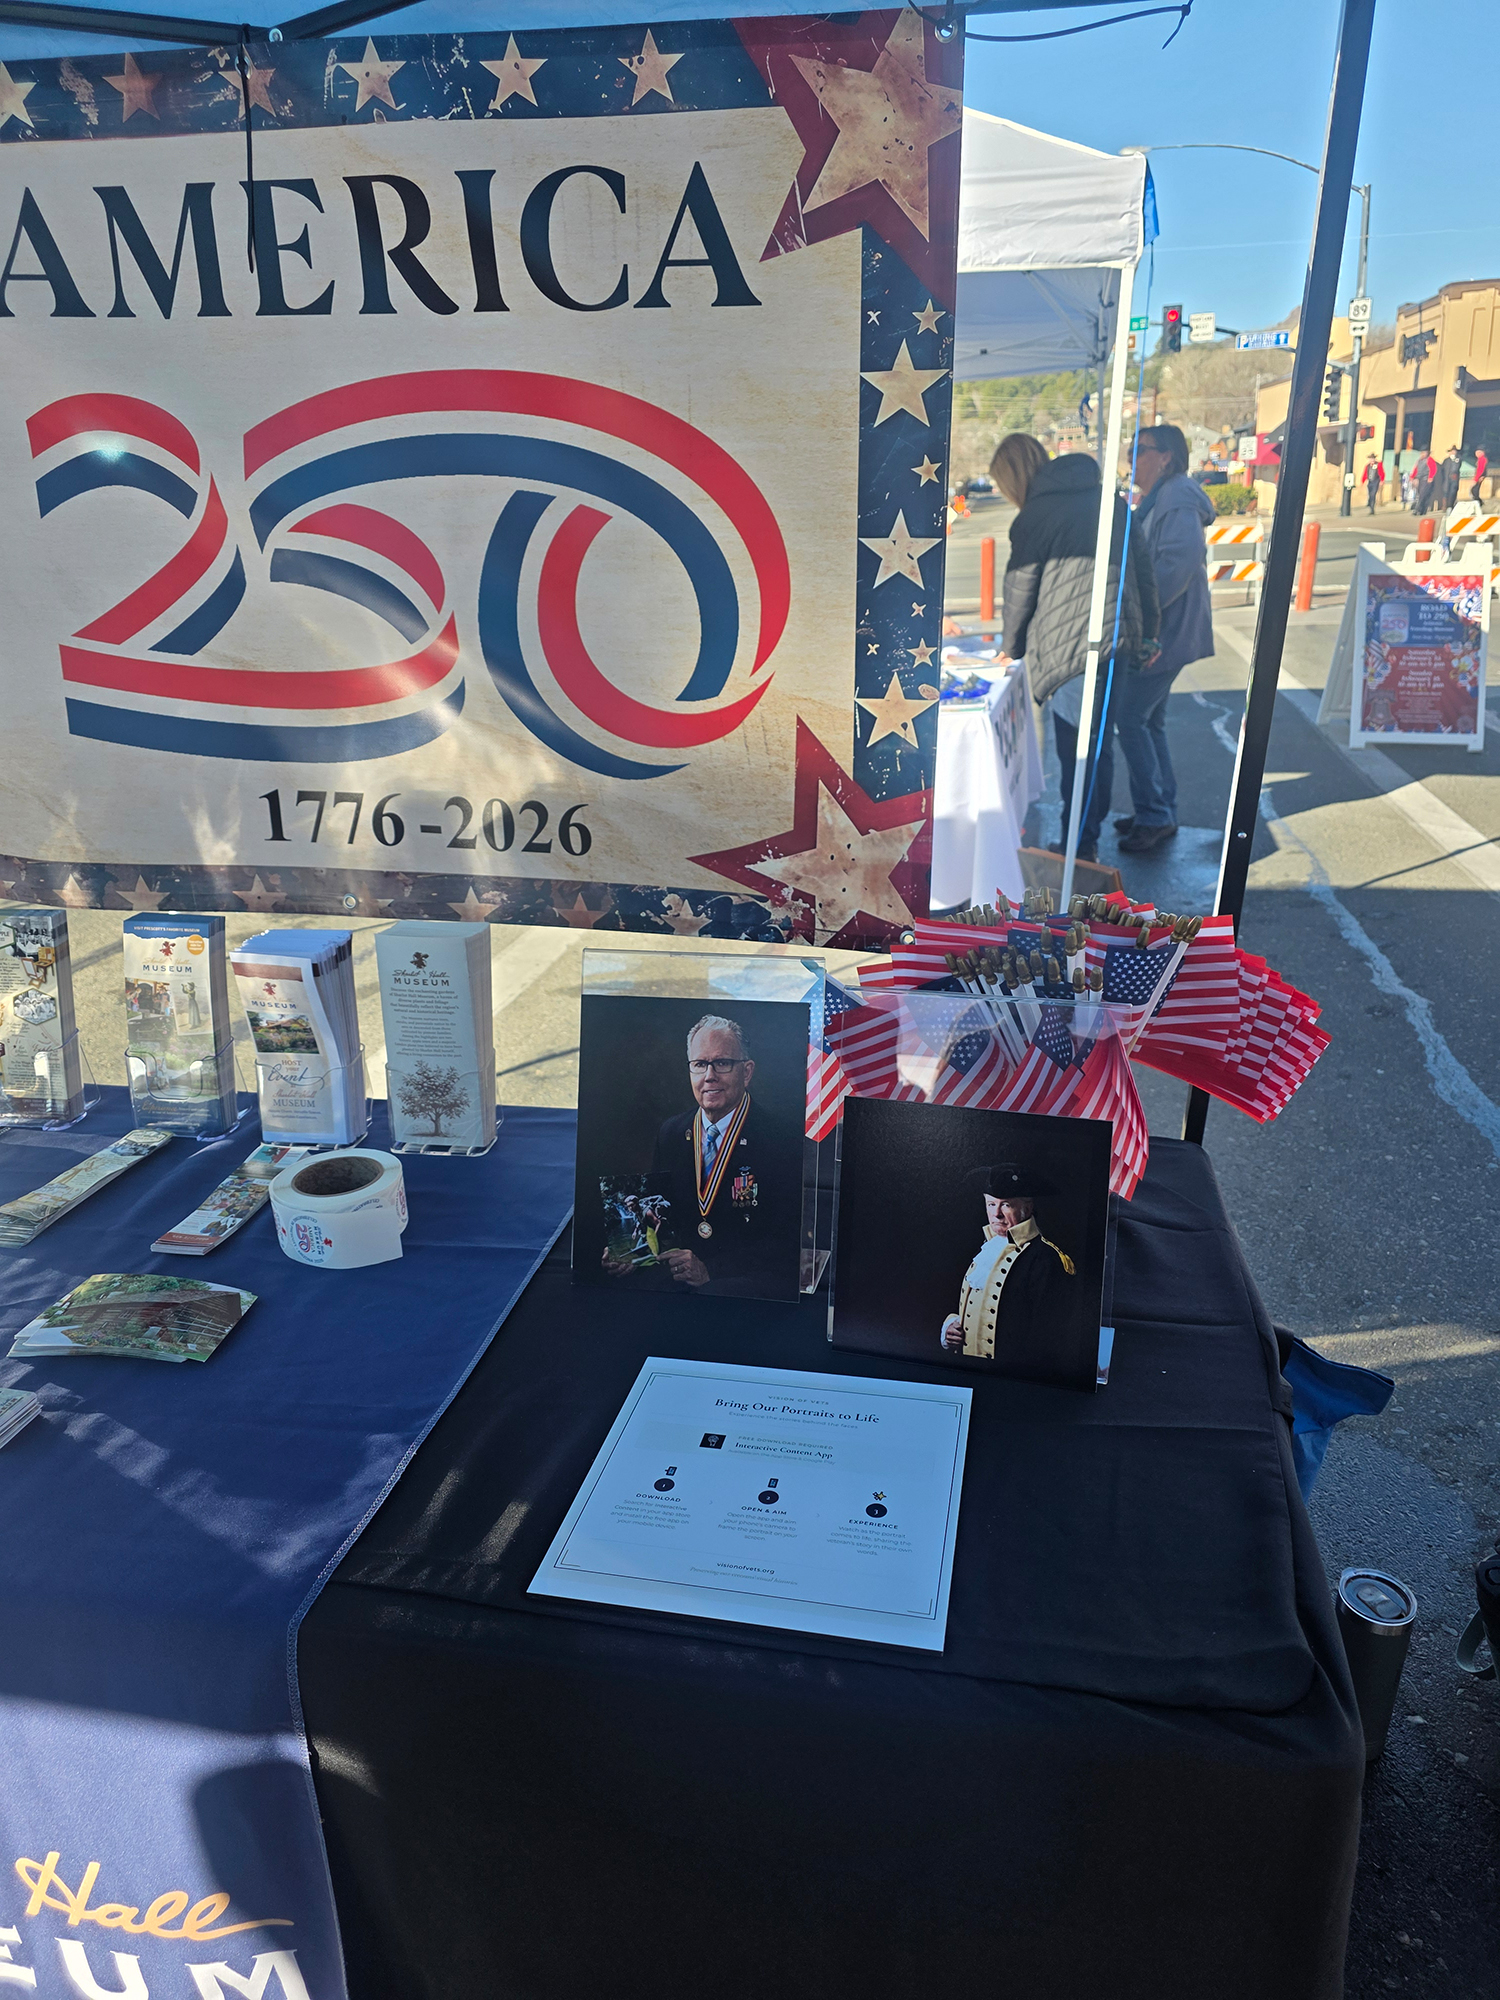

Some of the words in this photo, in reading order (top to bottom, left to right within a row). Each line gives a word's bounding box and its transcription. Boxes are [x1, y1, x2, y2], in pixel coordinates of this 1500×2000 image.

[0, 160, 763, 320] AMERICA
[1352, 304, 1367, 317] 89
[26, 368, 791, 780] 250
[257, 787, 593, 857] 1776-2026
[142, 964, 193, 973] MUSEUM
[393, 977, 450, 986] MUSEUM
[251, 1000, 297, 1009] MUSEUM
[272, 1098, 316, 1108] MUSEUM
[295, 1223, 311, 1253] 250
[714, 1398, 749, 1411] Bring
[752, 1402, 778, 1412] Our
[780, 1405, 834, 1418] Portraits
[855, 1413, 879, 1423] Life
[728, 1410, 765, 1419] Experience
[734, 1441, 777, 1452] Interactive
[779, 1446, 812, 1456] Content
[814, 1451, 832, 1459] App
[756, 1437, 796, 1445] DOWNLOAD
[798, 1442, 833, 1450] REQUIRED
[635, 1492, 681, 1502] DOWNLOAD
[848, 1518, 898, 1529] EXPERIENCE
[716, 1562, 775, 1575] visionofvets.org
[15, 1850, 295, 1941] Hall
